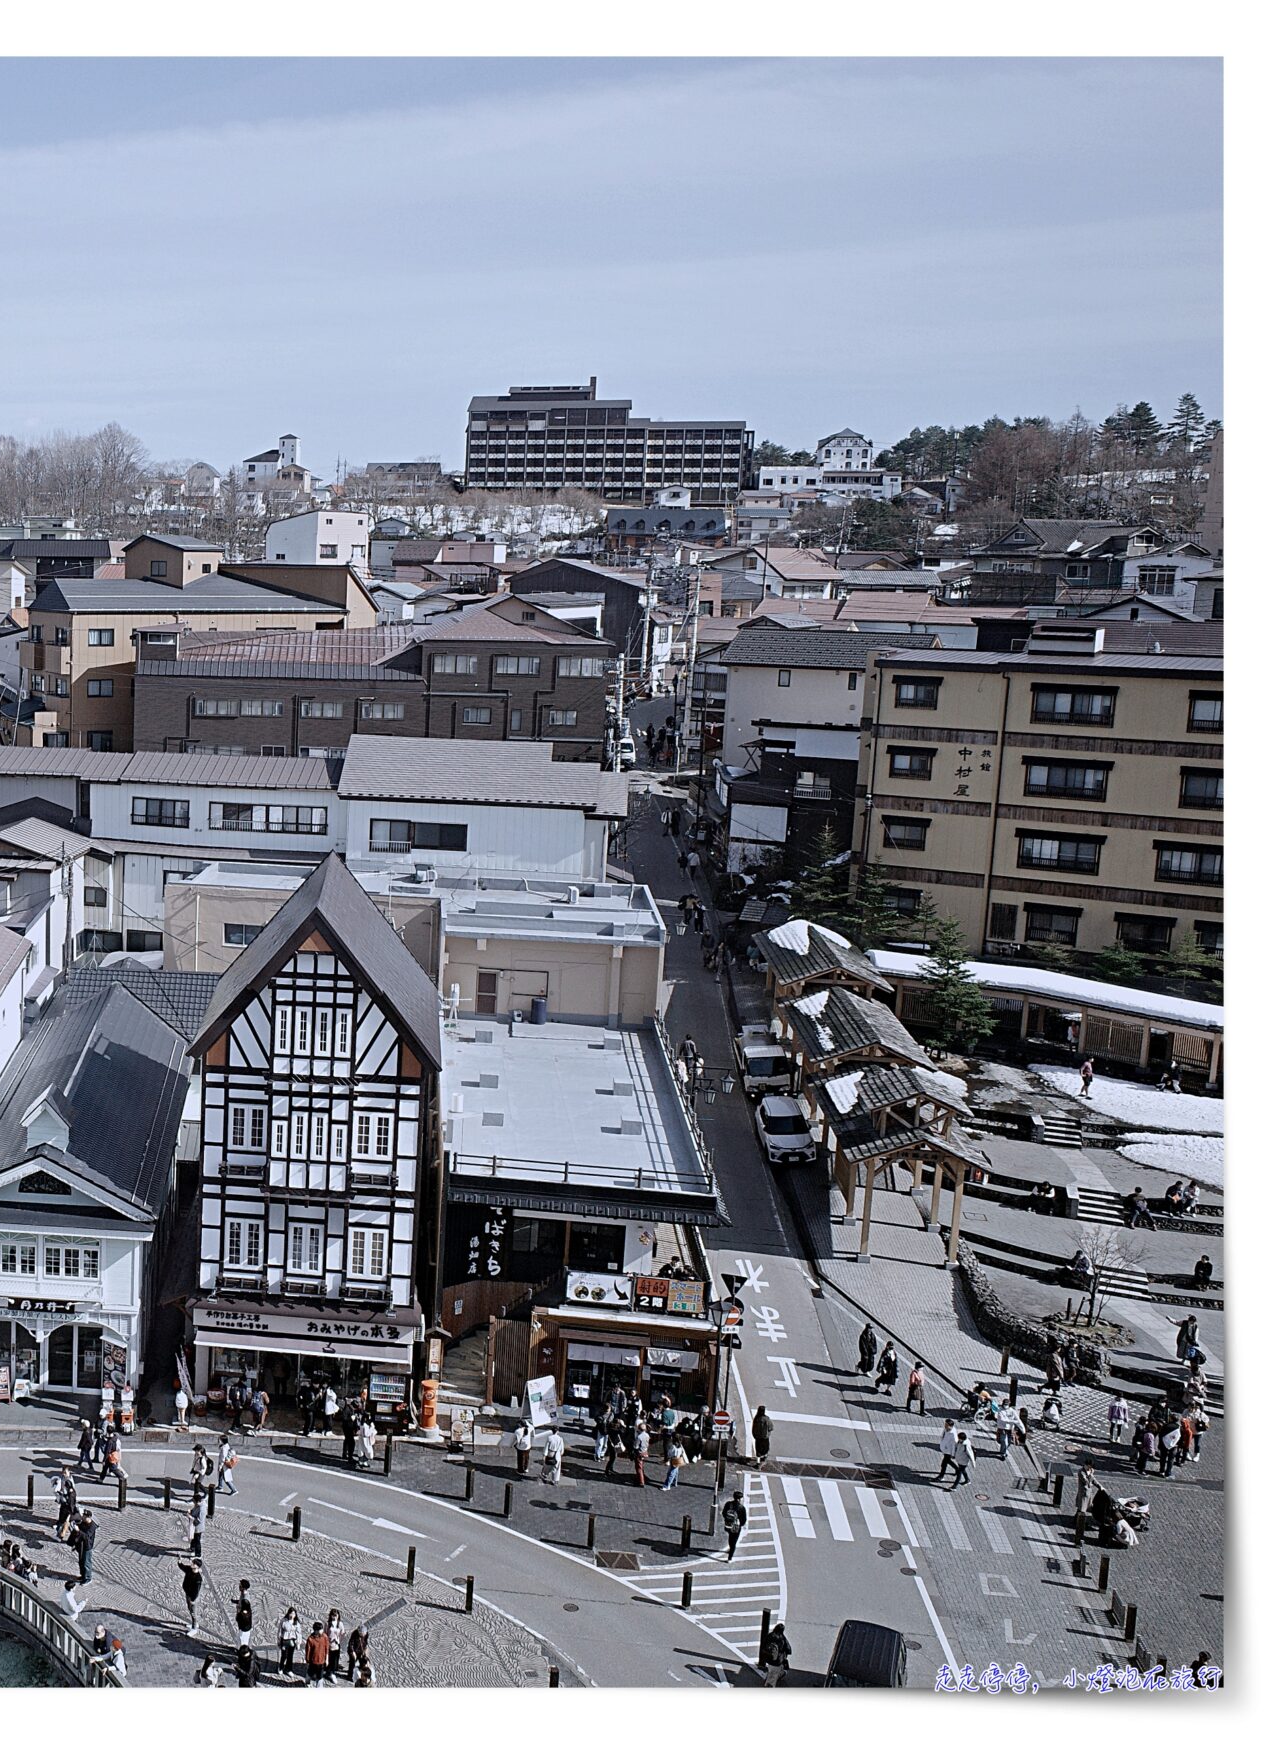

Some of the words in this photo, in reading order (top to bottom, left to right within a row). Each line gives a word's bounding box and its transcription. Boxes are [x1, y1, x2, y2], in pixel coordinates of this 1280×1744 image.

[953, 746, 973, 797] 中村屋
[639, 1296, 664, 1309] 2階
[306, 1321, 401, 1340] おみやげの本多
